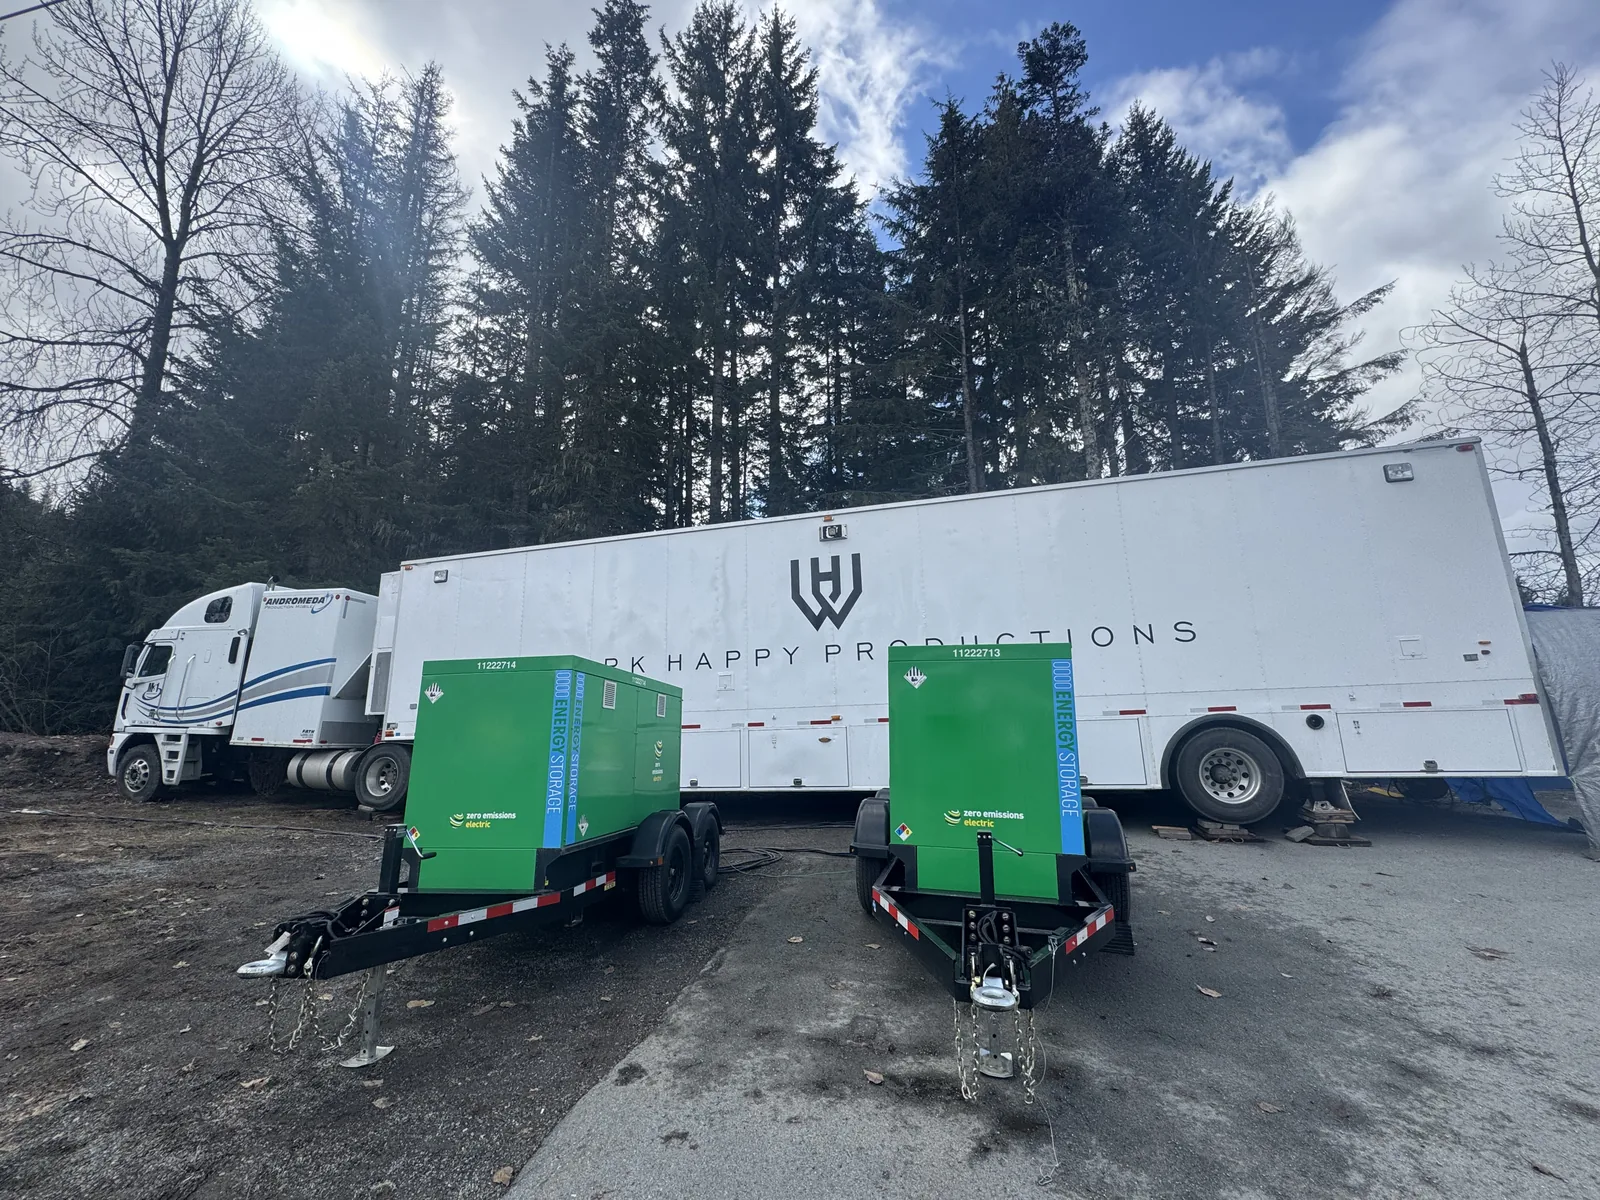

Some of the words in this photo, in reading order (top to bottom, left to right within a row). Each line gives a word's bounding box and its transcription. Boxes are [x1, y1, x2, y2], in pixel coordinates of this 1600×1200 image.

[265, 596, 326, 605] ANDROMEDA
[668, 646, 799, 671] HAPPY
[952, 648, 1001, 657] 11222713
[477, 661, 516, 670] 11222714
[552, 699, 568, 754] ENERGY
[572, 699, 582, 752] ENERGY
[1055, 691, 1075, 753] ENERGY
[547, 755, 565, 814] STORAGE
[568, 753, 579, 812] STORAGE
[1058, 752, 1079, 818] STORAGE
[482, 811, 516, 819] emissions
[963, 818, 995, 828] electric
[983, 810, 1024, 820] emissions
[465, 820, 491, 828] electric
